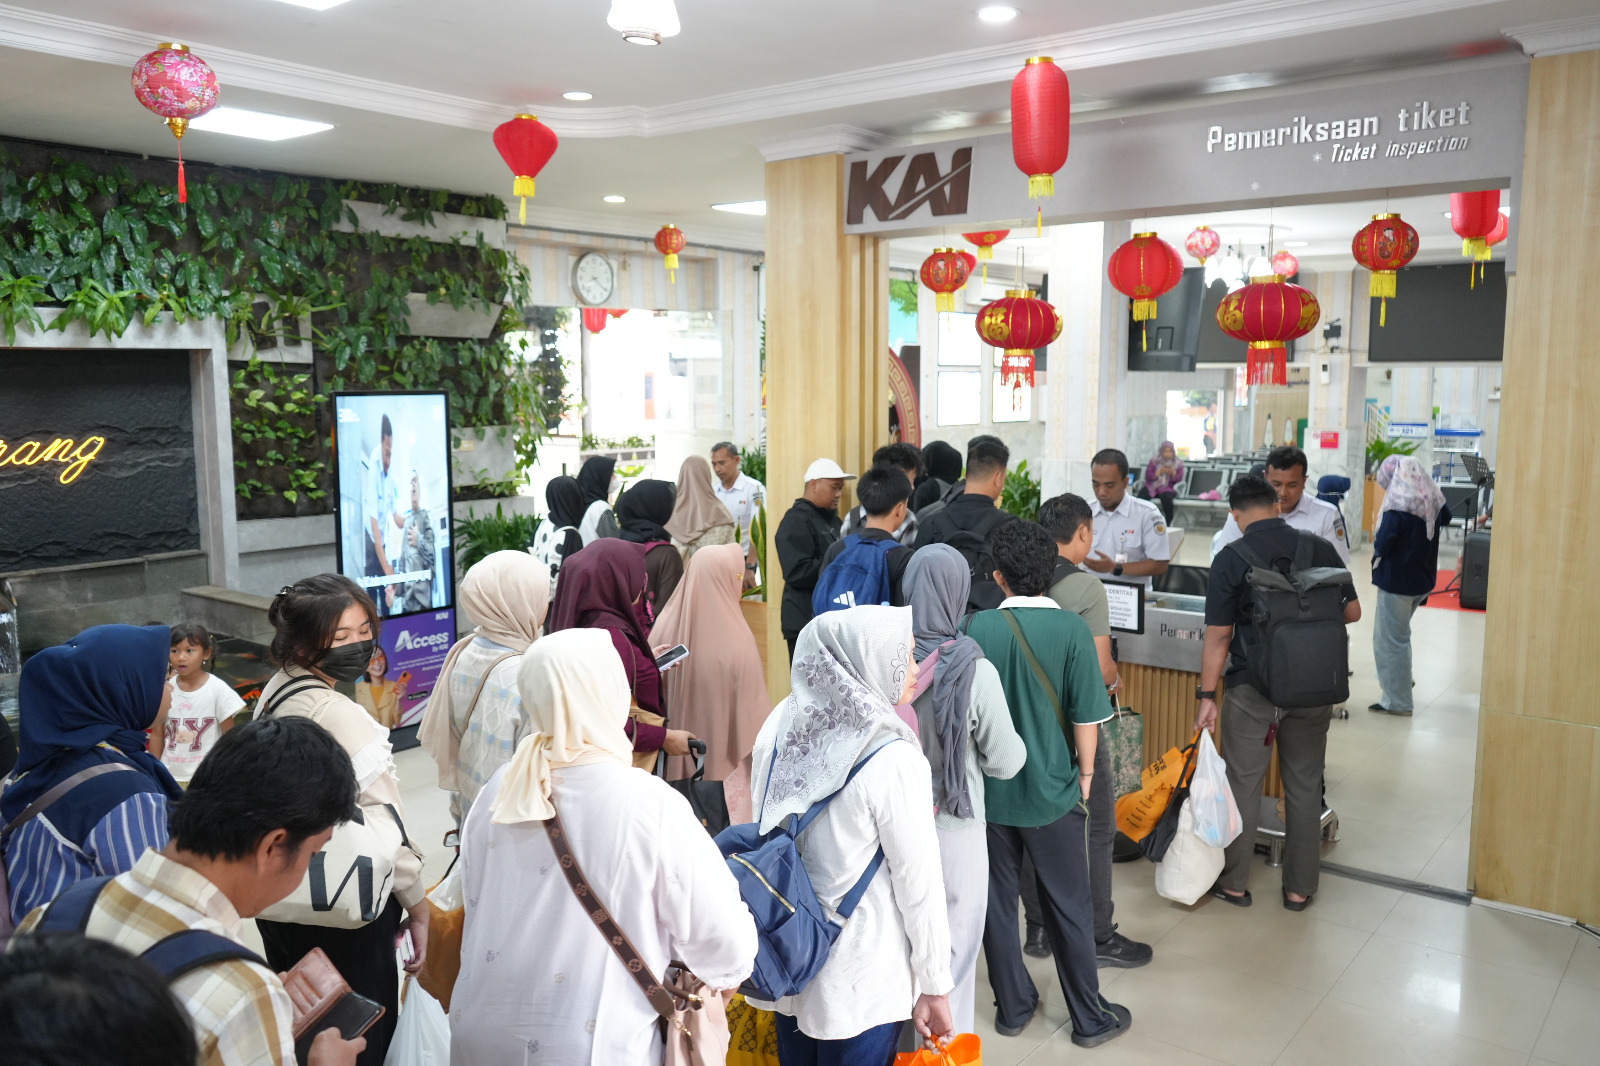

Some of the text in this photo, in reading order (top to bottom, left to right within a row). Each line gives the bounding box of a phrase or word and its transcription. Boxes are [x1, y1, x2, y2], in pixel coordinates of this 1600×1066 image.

[1207, 101, 1472, 153] Pemeriksaan tiket
[1331, 135, 1470, 163] Ticket inspection
[846, 146, 973, 226] KAI
[1107, 588, 1133, 597] IDENTITAS
[394, 629, 450, 653] Access
[164, 717, 215, 753] NY
